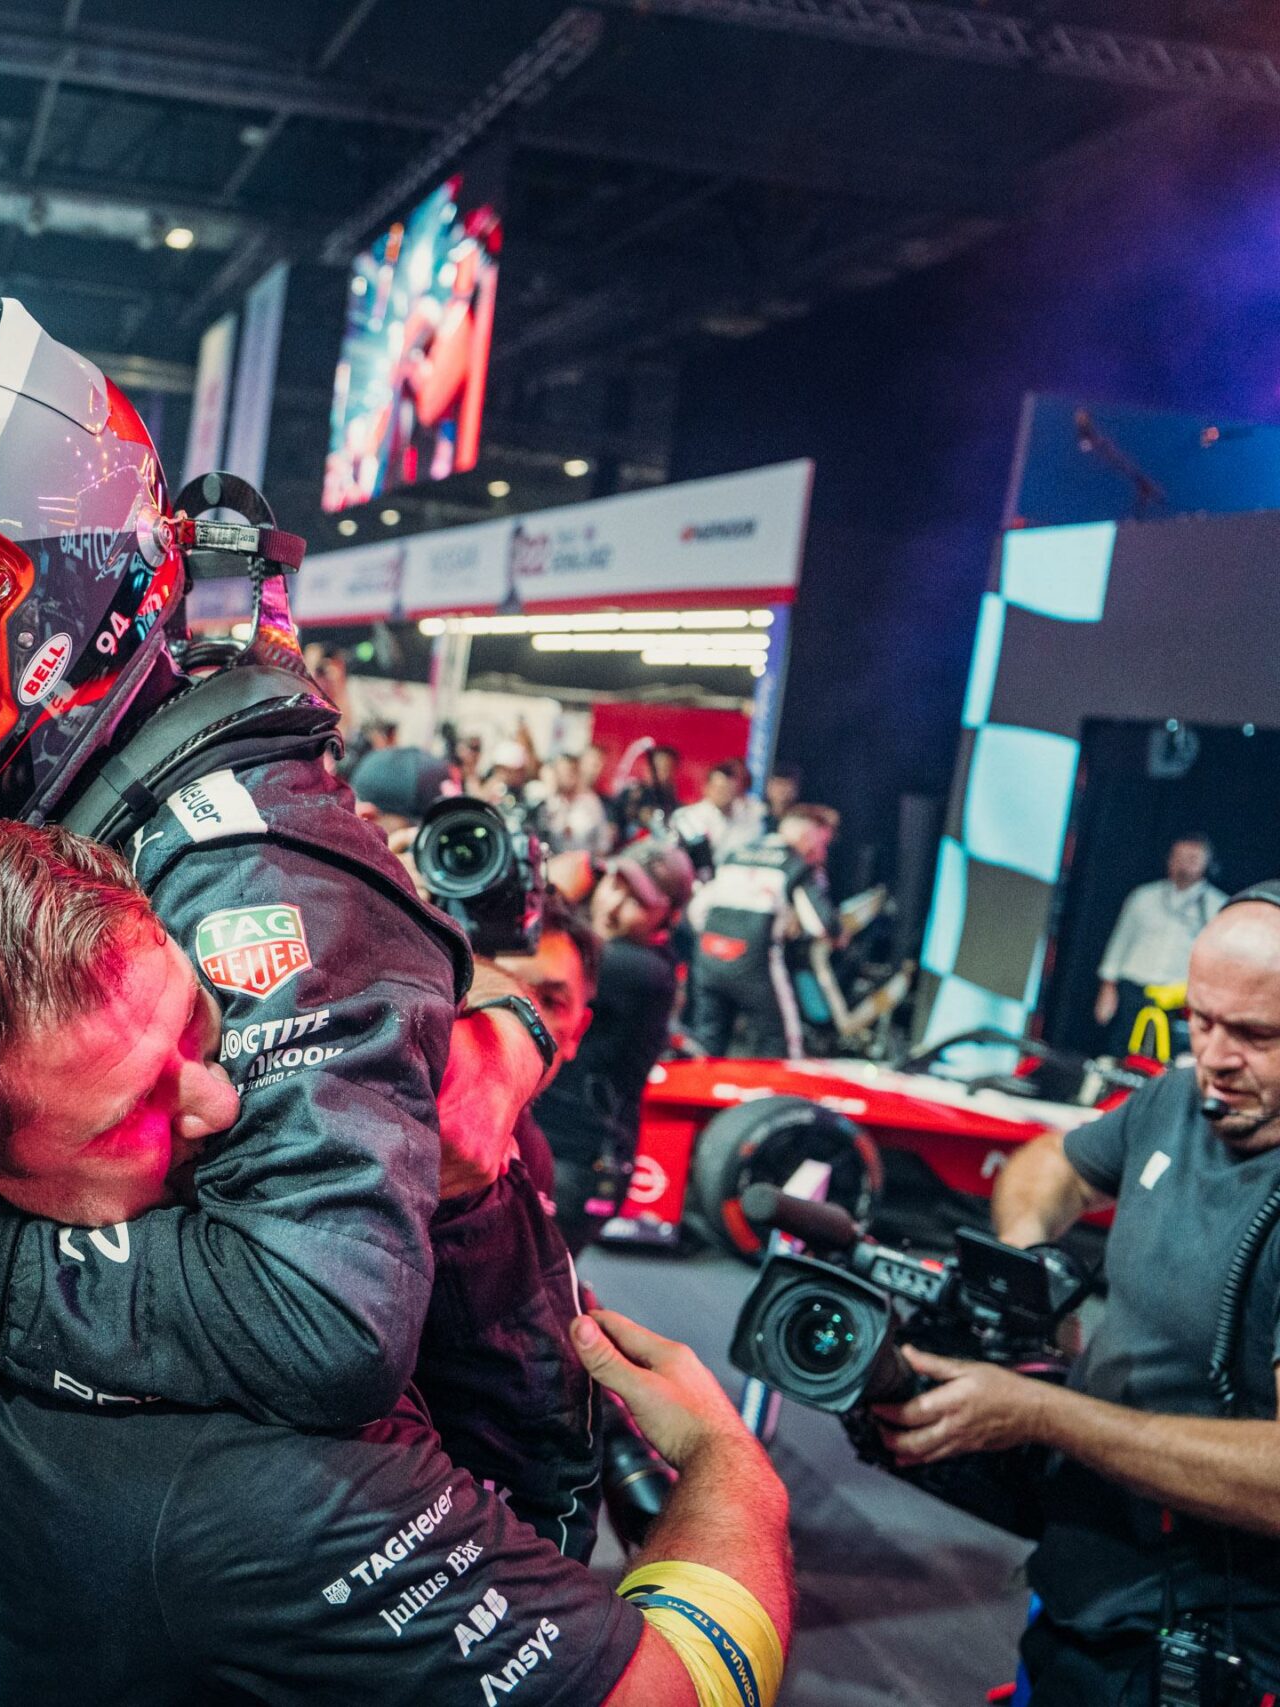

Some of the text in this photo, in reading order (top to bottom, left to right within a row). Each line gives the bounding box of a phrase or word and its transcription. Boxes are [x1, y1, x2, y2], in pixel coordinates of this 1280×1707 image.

[96, 611, 131, 656] 94
[23, 645, 66, 696] BELL
[201, 910, 297, 948] TAG
[206, 943, 305, 990] HEUER
[379, 1539, 484, 1638] Julius Bär
[454, 1588, 508, 1658] ABB
[480, 1617, 561, 1707] Ansys
[723, 1638, 756, 1707] ORMULA
